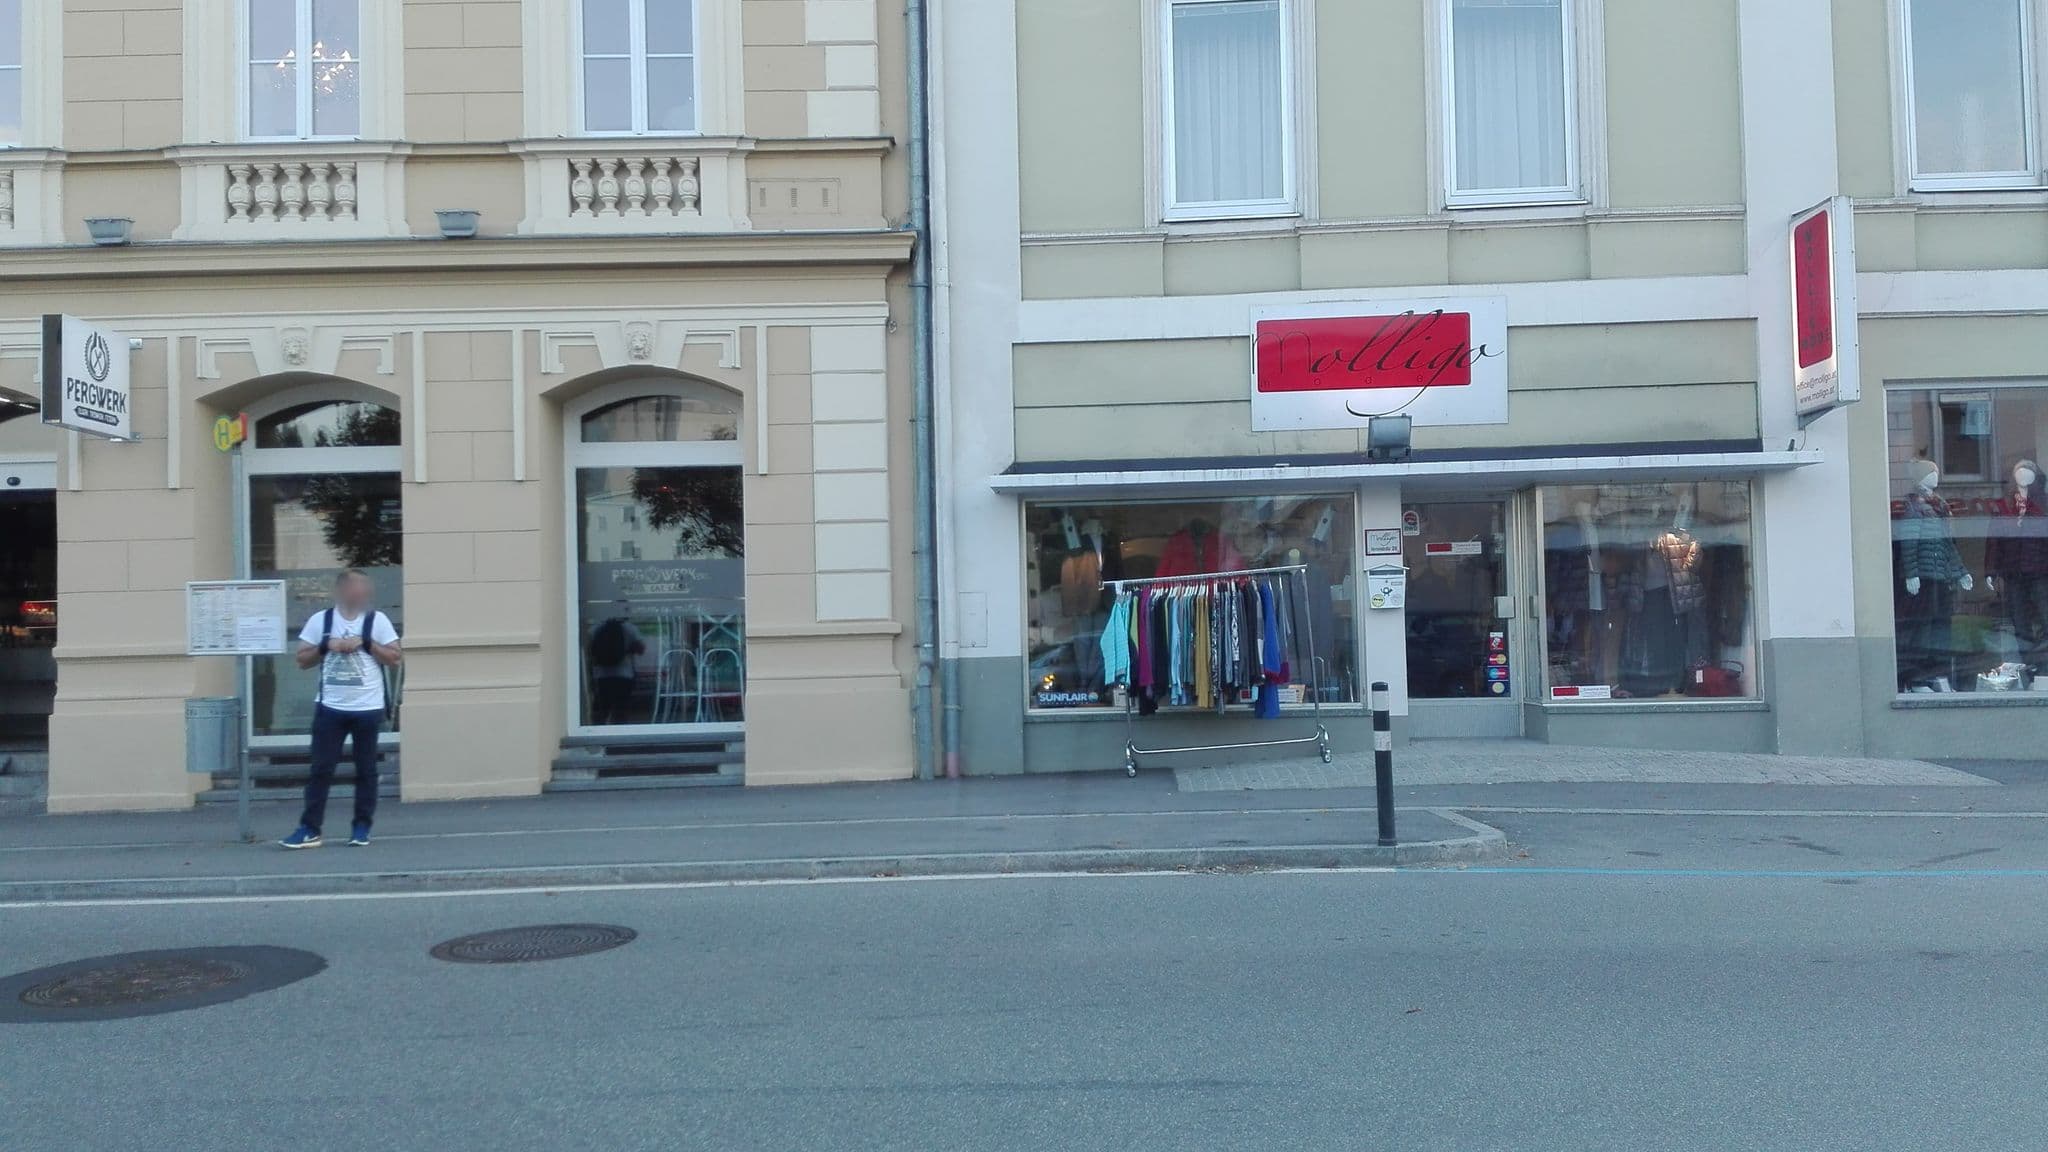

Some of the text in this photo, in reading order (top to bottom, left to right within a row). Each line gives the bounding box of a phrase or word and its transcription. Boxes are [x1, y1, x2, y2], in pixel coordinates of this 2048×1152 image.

[1251, 309, 1504, 417] Molligo
[66, 377, 127, 414] PERGWERK
[1039, 692, 1088, 702] SUNFLAIR
